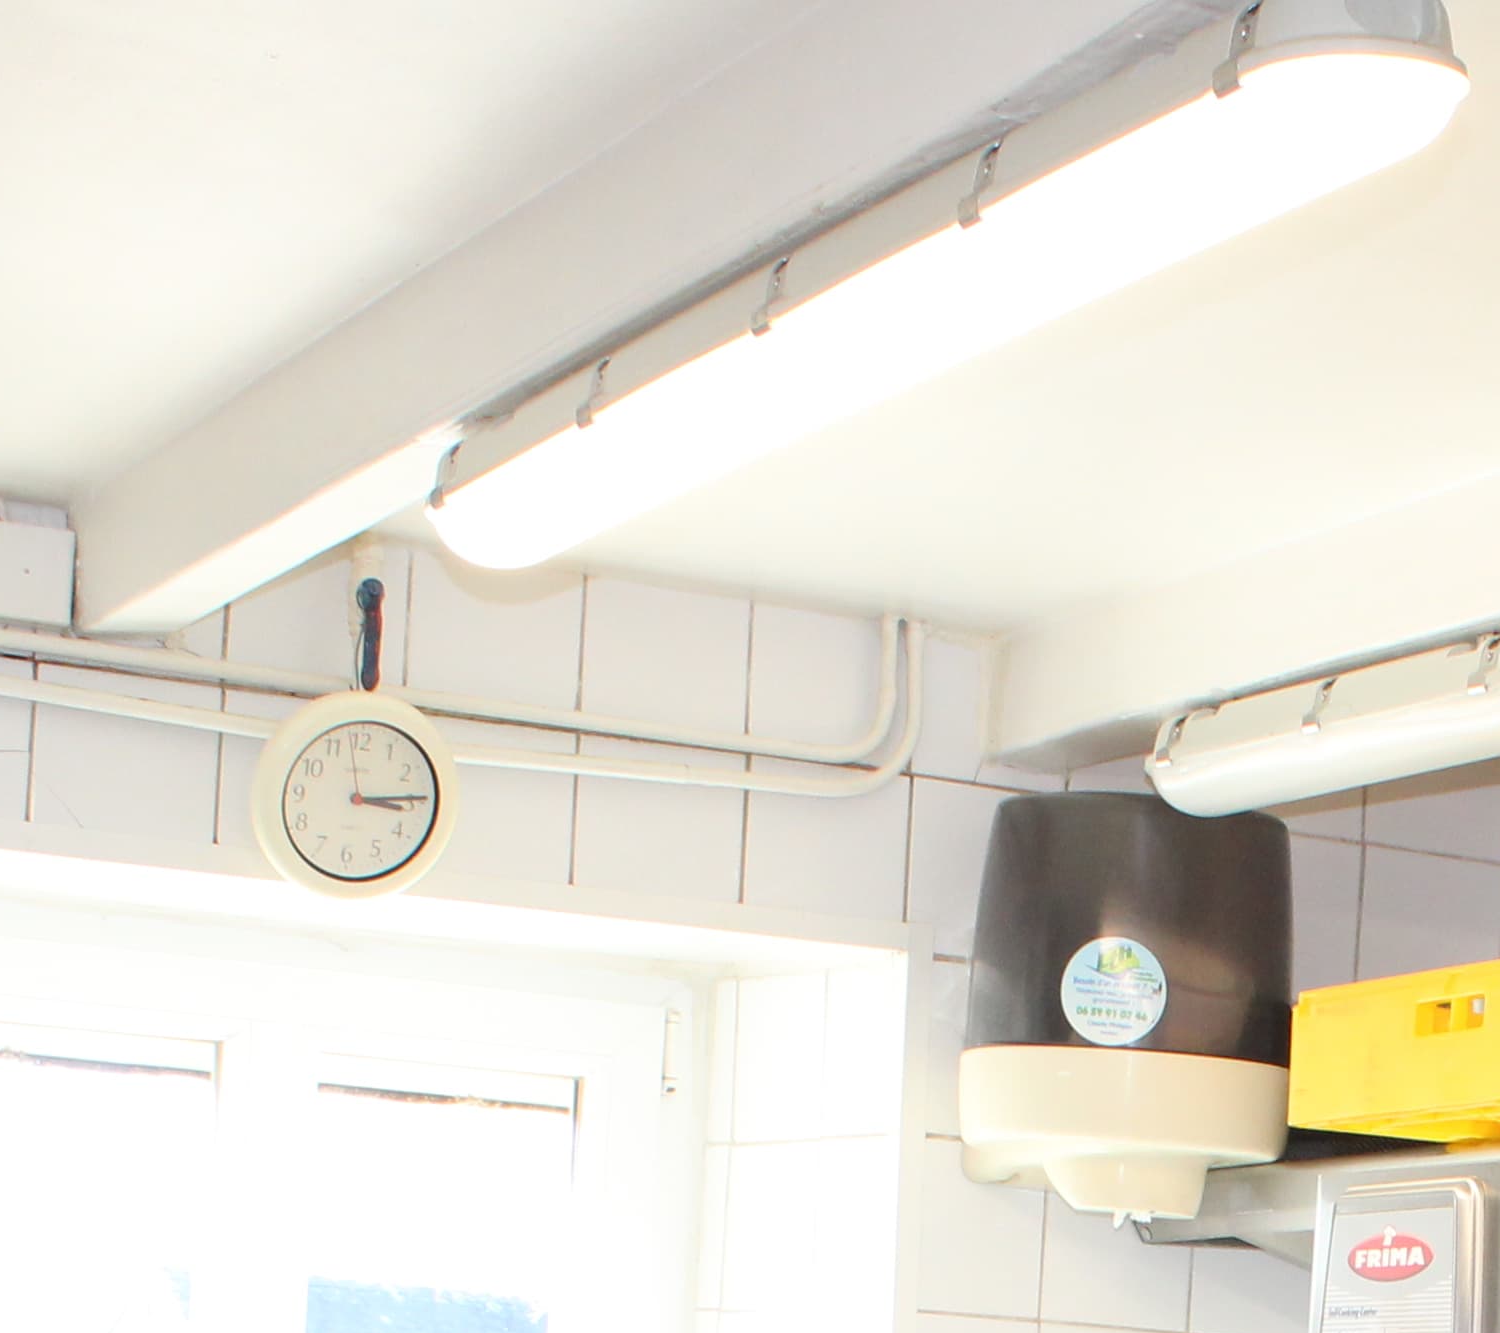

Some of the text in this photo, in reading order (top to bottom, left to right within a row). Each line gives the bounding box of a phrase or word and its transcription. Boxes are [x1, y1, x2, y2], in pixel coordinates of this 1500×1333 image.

[325, 739, 341, 758] 11
[352, 732, 371, 752] 12
[304, 758, 323, 778] 10
[399, 763, 411, 782] 2
[293, 784, 305, 801] 9
[296, 812, 308, 831] 8
[391, 822, 403, 838] 4
[317, 835, 327, 853] 7
[370, 840, 381, 858] 5
[341, 846, 353, 863] 6
[1355, 1246, 1425, 1269] FRIMA
